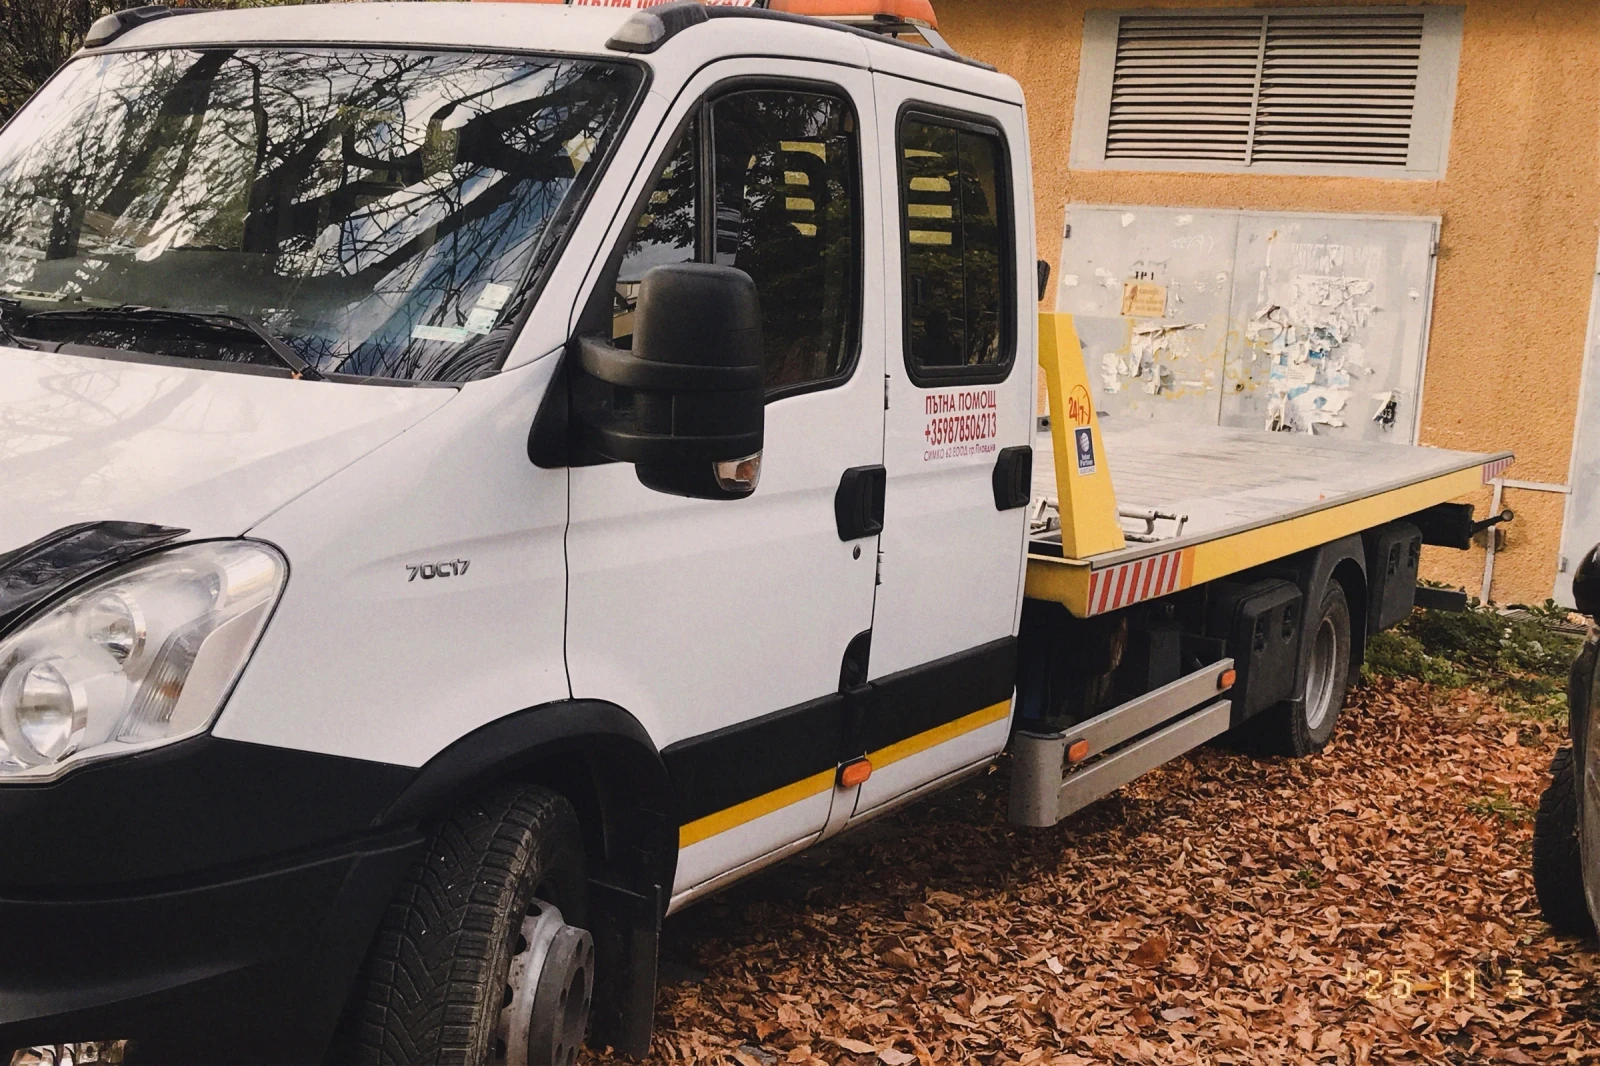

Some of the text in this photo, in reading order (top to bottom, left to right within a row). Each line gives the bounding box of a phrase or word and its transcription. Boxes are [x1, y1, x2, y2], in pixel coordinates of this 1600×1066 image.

[925, 390, 997, 415] ПЪТНА ПОМОЩ
[925, 411, 997, 446] +359878506213
[405, 558, 471, 582] 70C17
